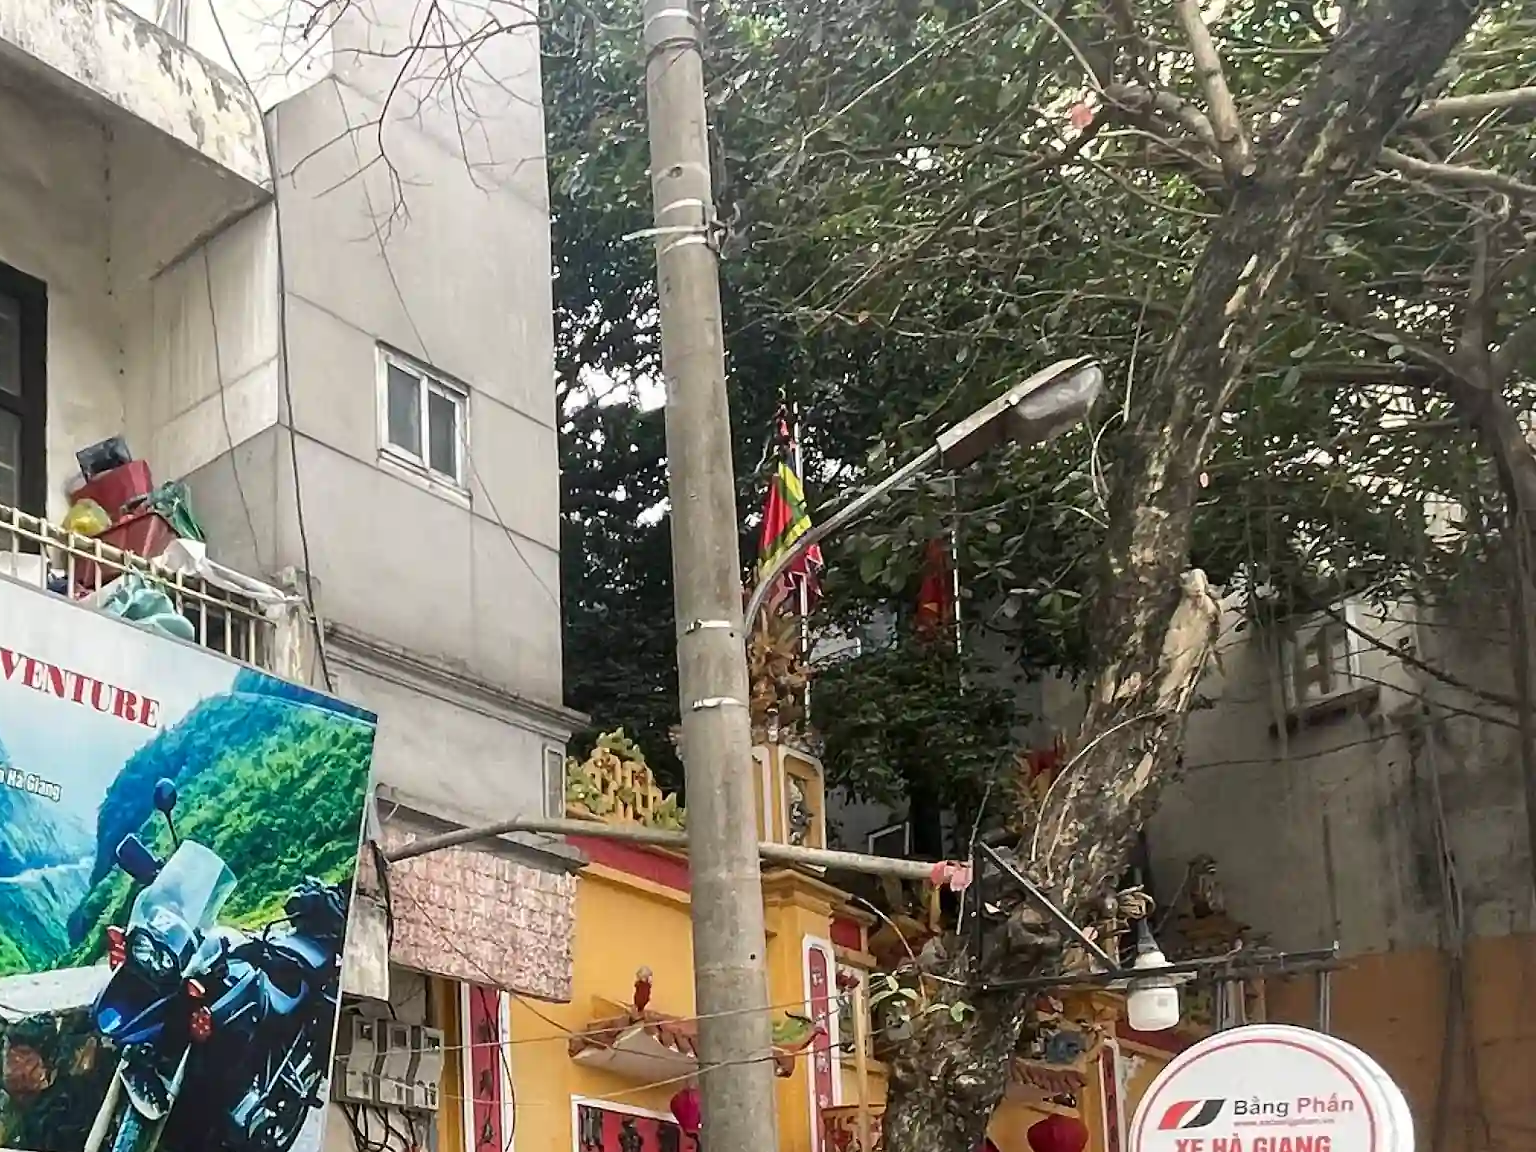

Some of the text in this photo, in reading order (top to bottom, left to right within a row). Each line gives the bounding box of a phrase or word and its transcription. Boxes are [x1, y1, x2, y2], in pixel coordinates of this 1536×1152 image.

[7, 766, 25, 789] Hà
[26, 772, 62, 802] Giang
[1233, 1092, 1354, 1117] Bằng Phấn
